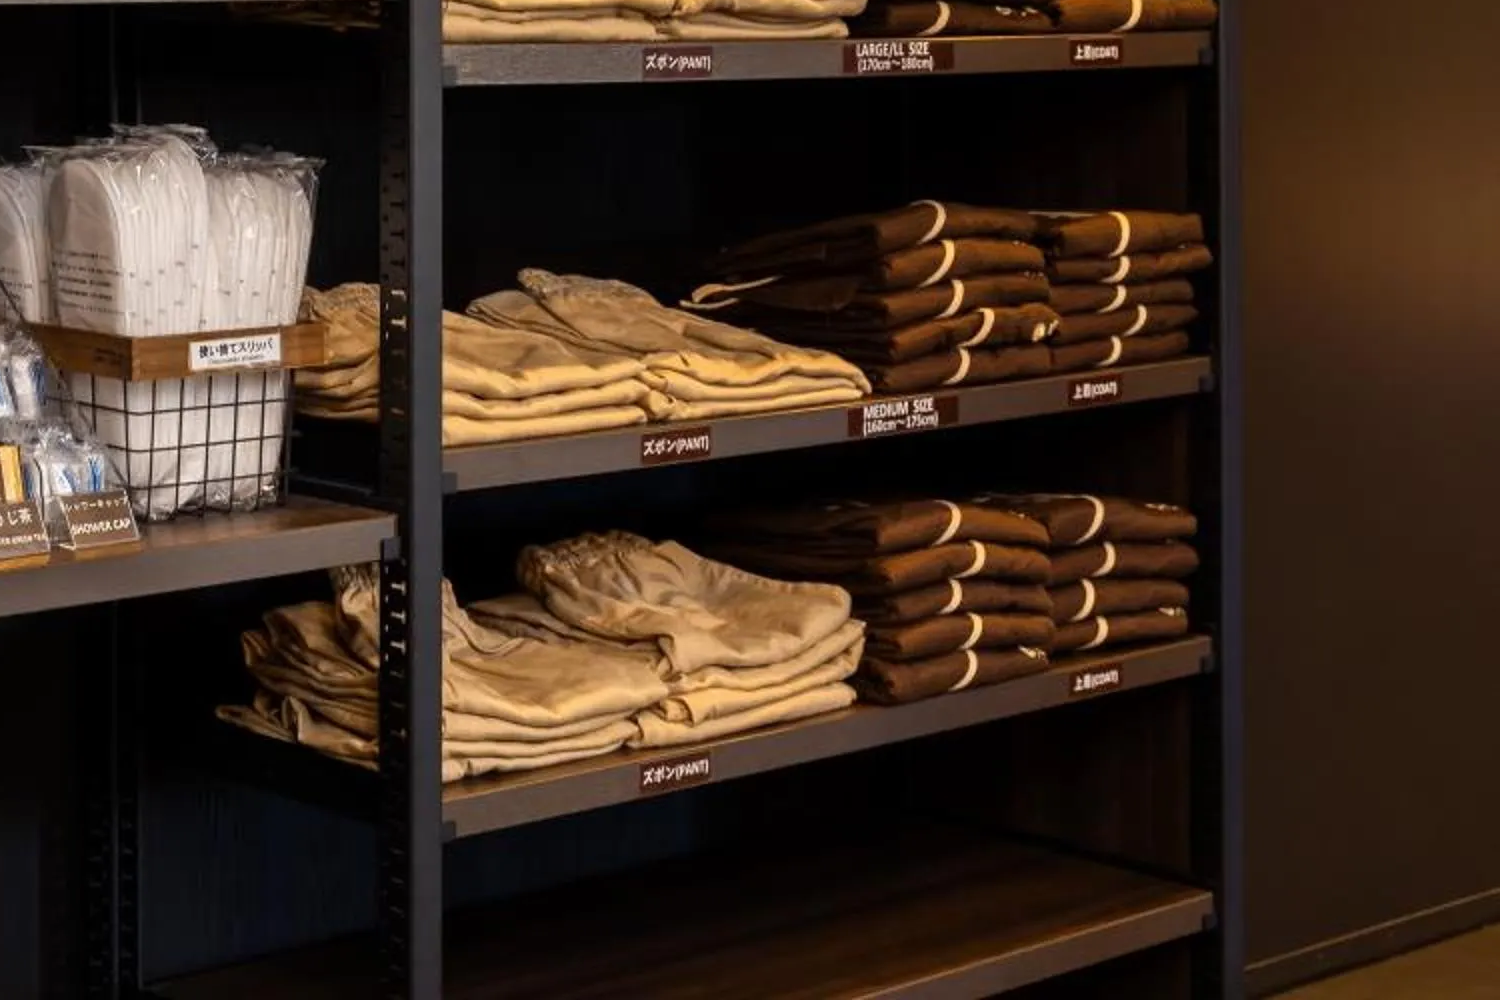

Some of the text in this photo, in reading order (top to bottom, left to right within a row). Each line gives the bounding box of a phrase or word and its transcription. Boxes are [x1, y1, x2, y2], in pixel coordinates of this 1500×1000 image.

[908, 41, 930, 56] SIZE
[863, 397, 934, 419] MEDIUM SIZE
